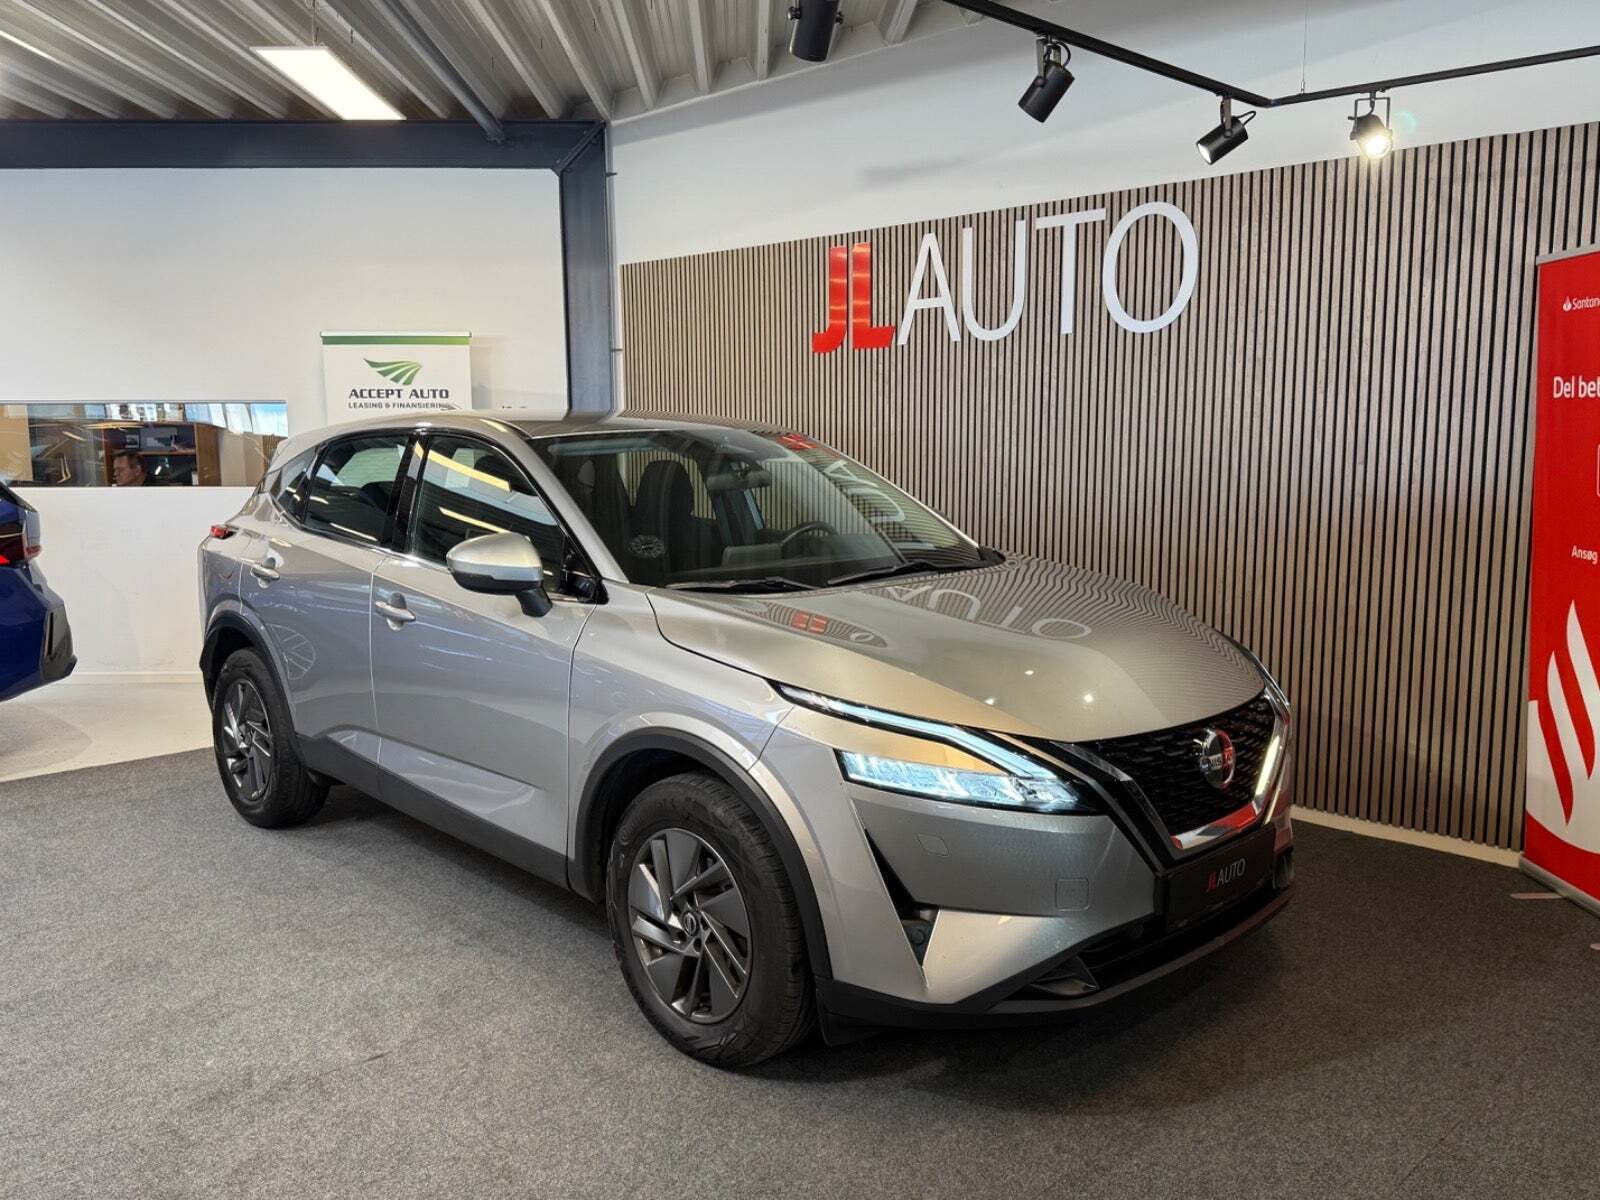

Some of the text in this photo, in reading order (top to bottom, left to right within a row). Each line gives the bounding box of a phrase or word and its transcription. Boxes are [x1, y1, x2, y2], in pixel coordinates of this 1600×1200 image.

[349, 388, 449, 399] ACCEPT AUTO
[1553, 376, 1575, 398] Del
[393, 402, 450, 410] FINANSIERIN
[1571, 545, 1598, 565] Ansøg
